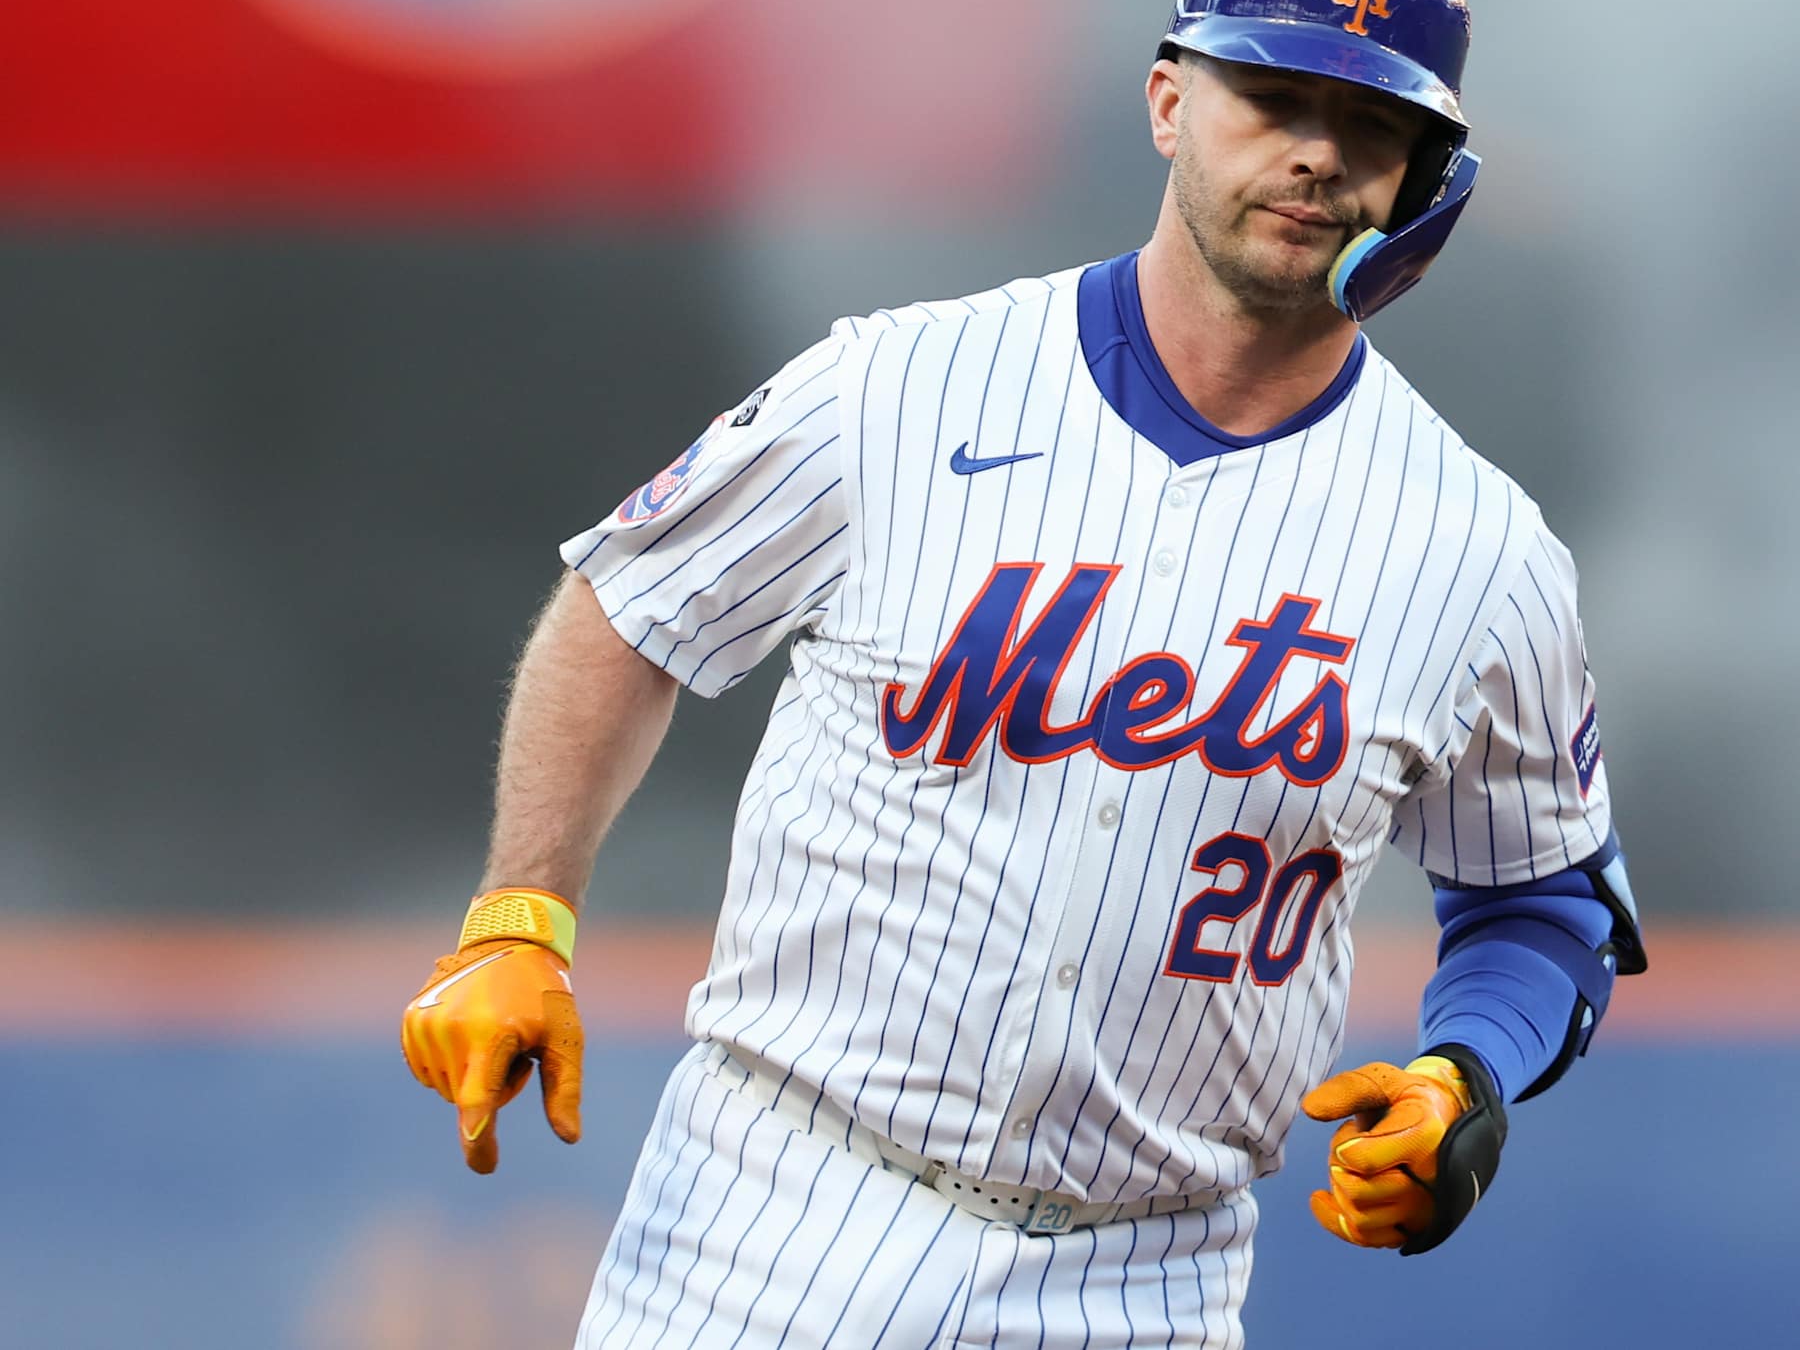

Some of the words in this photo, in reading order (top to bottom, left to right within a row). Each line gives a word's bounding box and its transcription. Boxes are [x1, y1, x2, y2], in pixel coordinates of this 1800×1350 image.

[884, 563, 1355, 787] Mets
[1162, 831, 1343, 987] 20
[1037, 1204, 1072, 1229] 20
